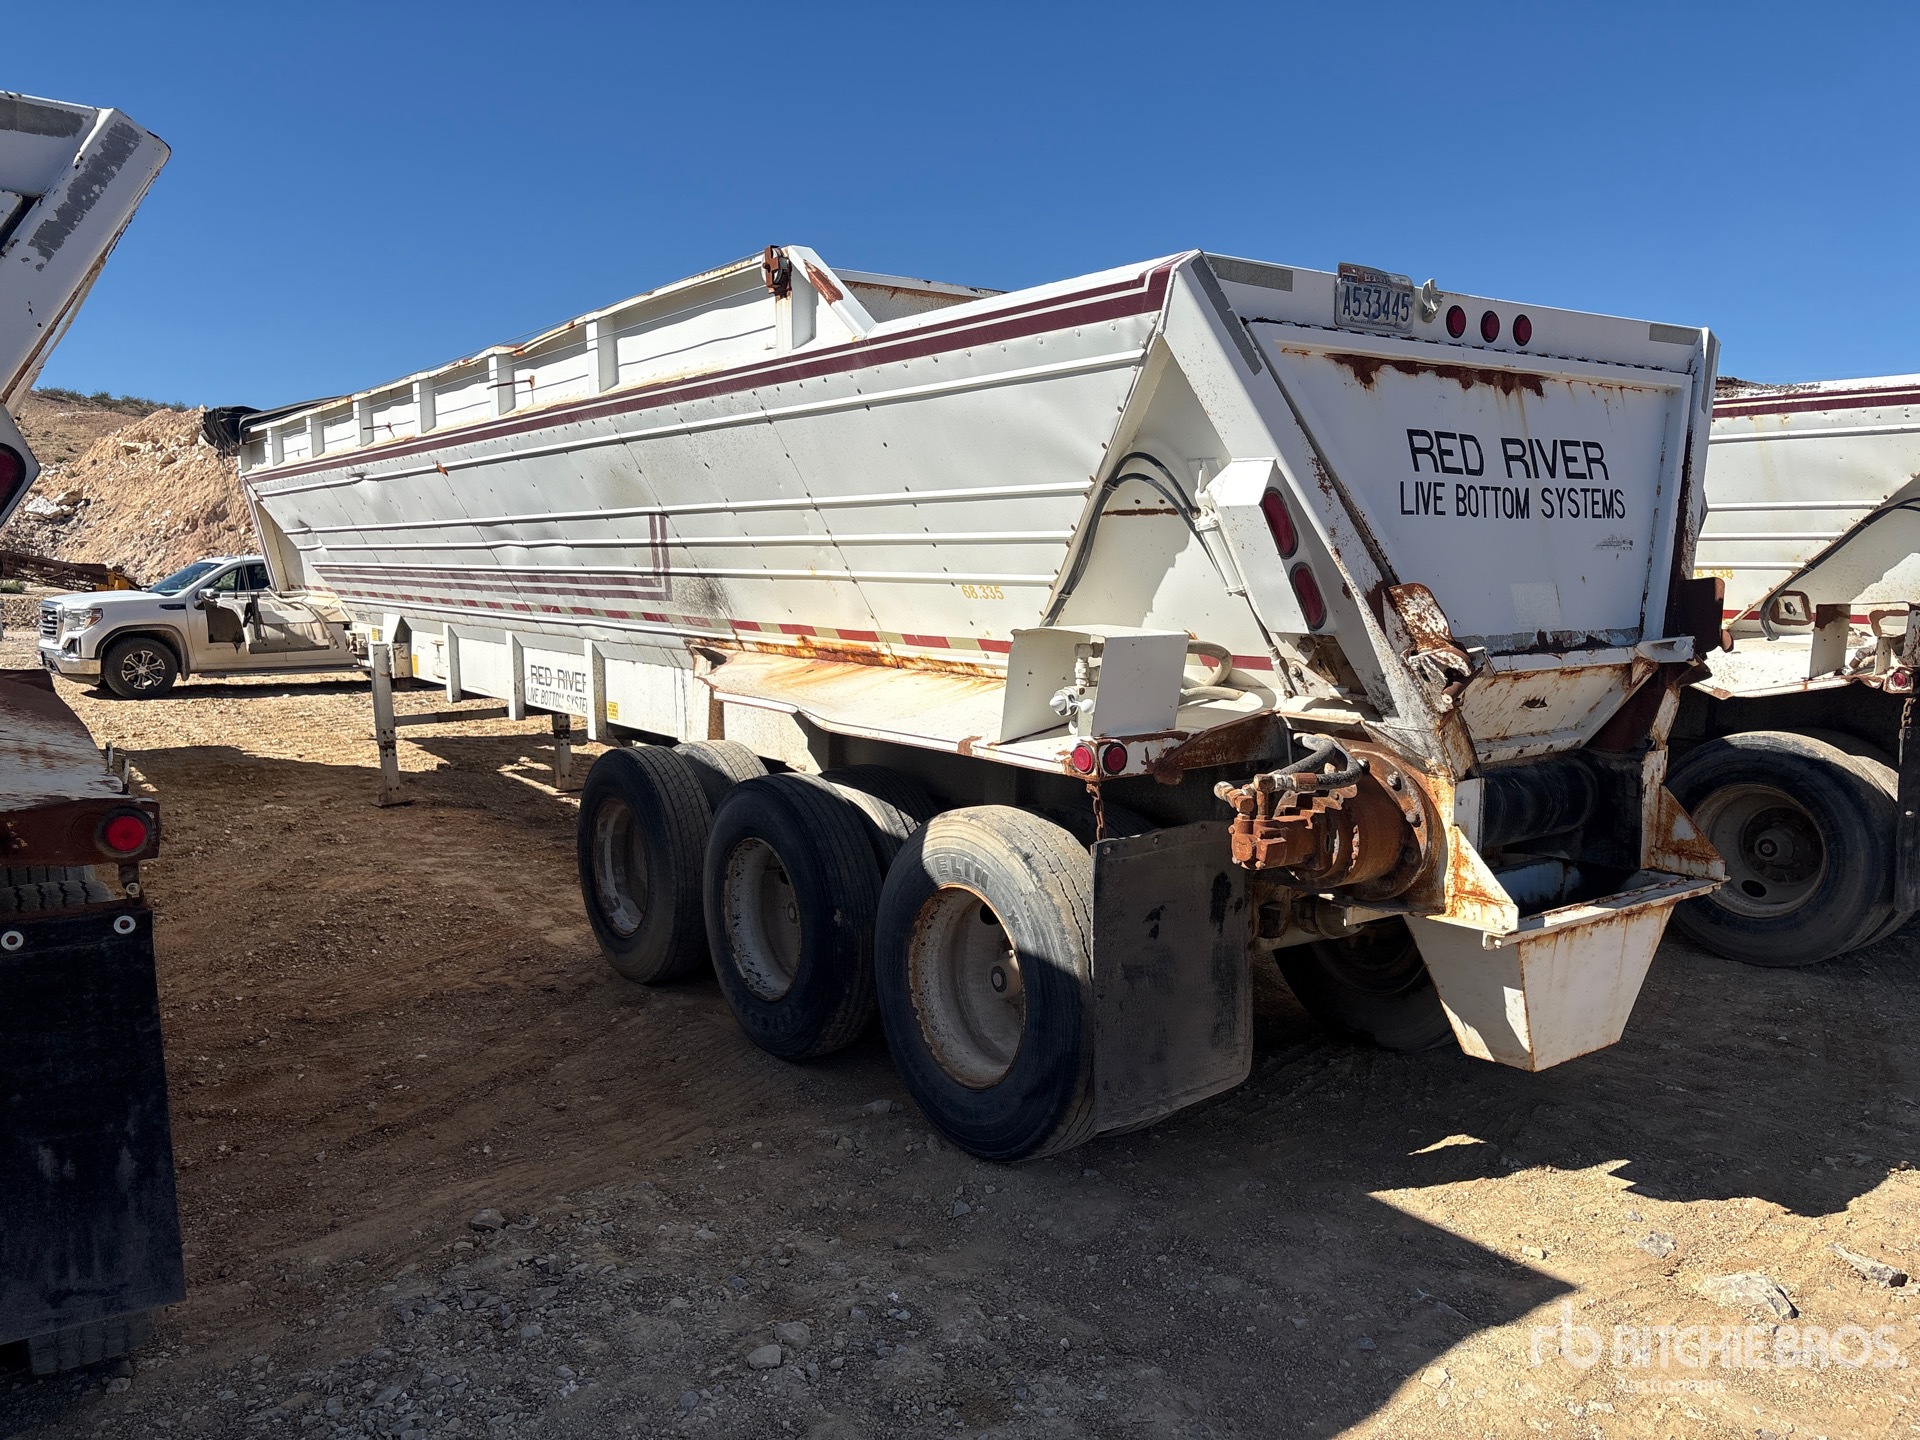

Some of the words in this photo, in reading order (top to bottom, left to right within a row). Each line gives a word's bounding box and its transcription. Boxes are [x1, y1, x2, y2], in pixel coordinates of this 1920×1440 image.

[1343, 285, 1410, 322] A533445
[1406, 428, 1485, 477] RED
[1501, 437, 1610, 481] RIVER
[1400, 481, 1447, 516] LIVE
[1455, 483, 1531, 519] BOTTOM
[1540, 487, 1627, 519] SYSTEMS
[961, 585, 1004, 600] 68.335
[530, 664, 552, 687] RED
[526, 686, 539, 704] LIVE
[566, 694, 588, 714] SYSTE
